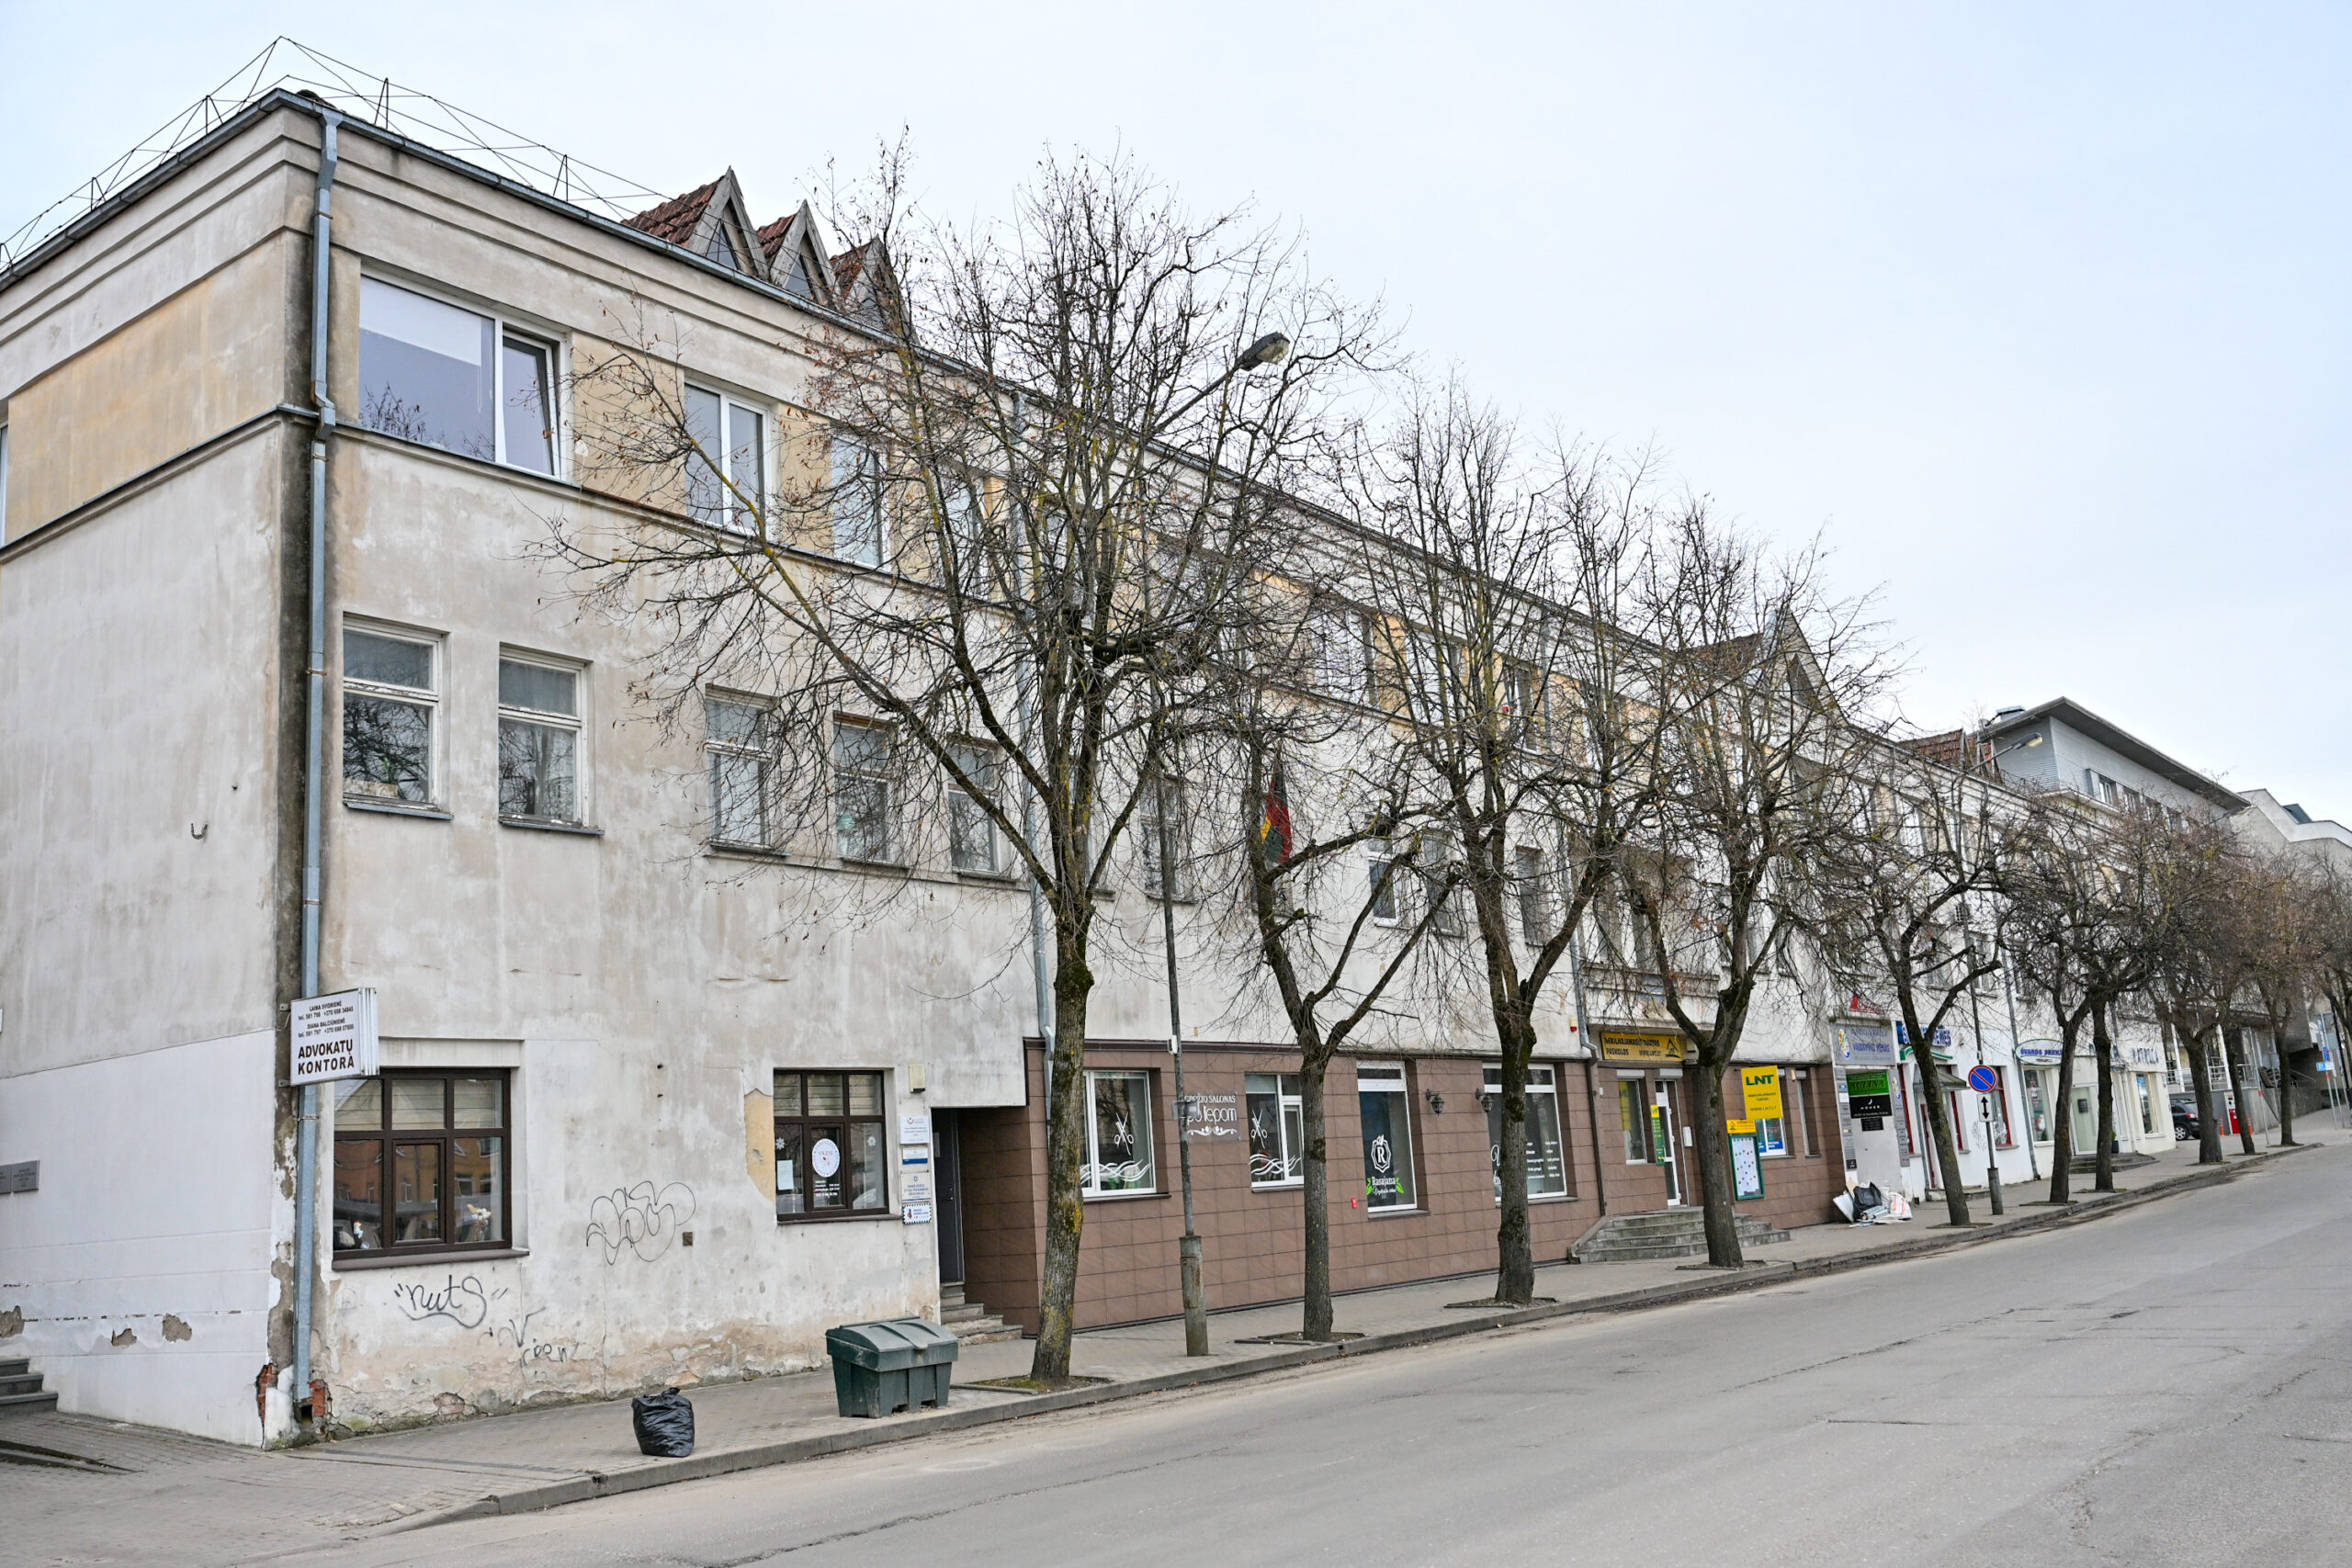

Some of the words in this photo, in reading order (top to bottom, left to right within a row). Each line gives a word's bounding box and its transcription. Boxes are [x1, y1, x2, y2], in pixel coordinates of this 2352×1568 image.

[298, 1039, 354, 1058] ADVOKATŲ
[298, 1055, 355, 1075] KONTORA
[1746, 1074, 1774, 1086] LNT
[1208, 1095, 1236, 1103] SALONAS
[1377, 1146, 1386, 1163] R
[1371, 1176, 1396, 1187] Rasajana
